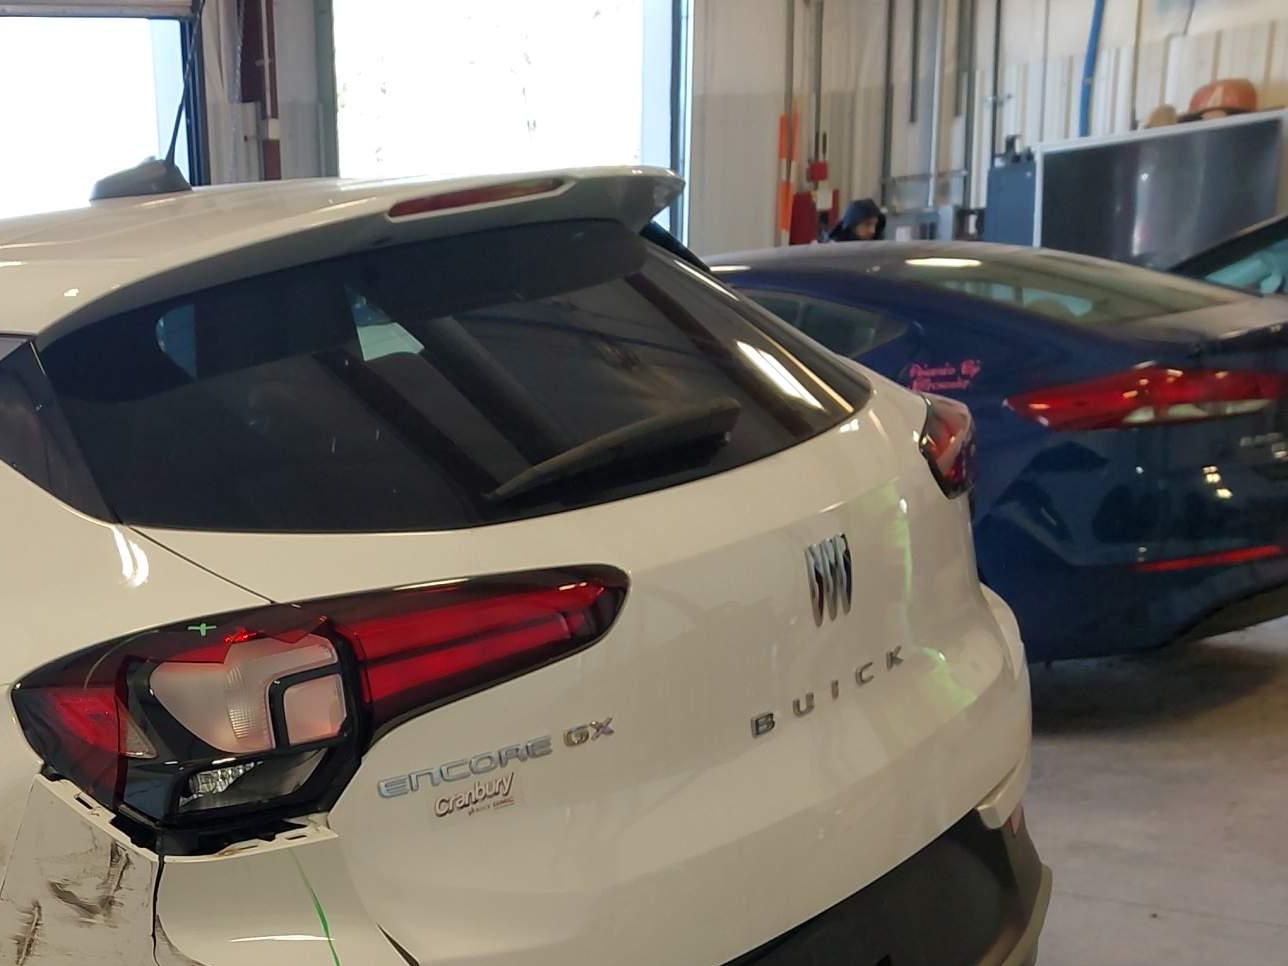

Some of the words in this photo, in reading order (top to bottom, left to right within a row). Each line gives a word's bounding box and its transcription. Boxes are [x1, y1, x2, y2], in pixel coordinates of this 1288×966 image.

[750, 645, 904, 739] BUICK
[377, 735, 554, 799] ENCORE
[562, 717, 615, 748] GX
[434, 771, 515, 818] Cranbury
